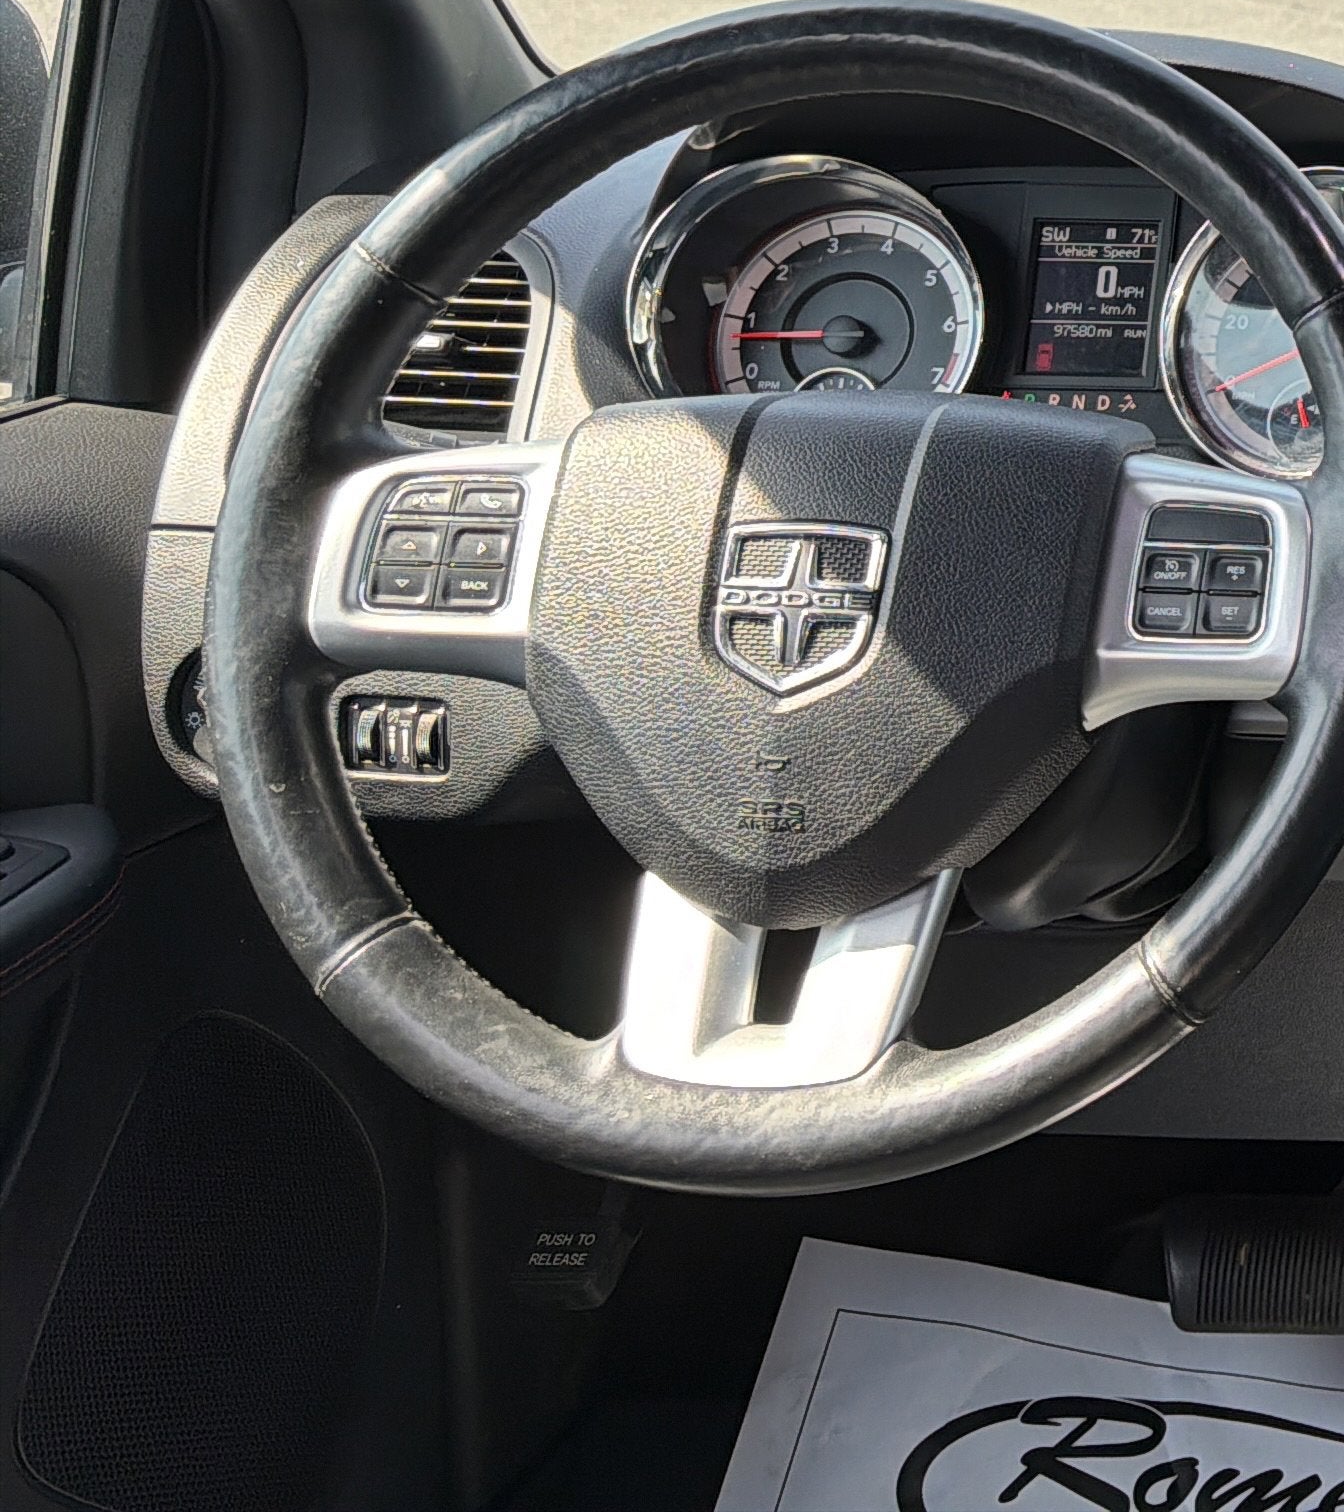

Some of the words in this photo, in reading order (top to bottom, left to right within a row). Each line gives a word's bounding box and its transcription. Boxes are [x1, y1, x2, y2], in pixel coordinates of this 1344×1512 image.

[1041, 226, 1071, 242] SW
[827, 239, 840, 255] 3
[880, 239, 895, 256] 4
[1055, 244, 1099, 258] Vehicle
[1102, 245, 1141, 260] Speed
[775, 265, 790, 282] 2
[924, 269, 938, 287] 5
[1096, 265, 1119, 299] 0
[1117, 286, 1145, 299] MPH
[1054, 301, 1083, 315] MPH
[1101, 302, 1137, 316] km/h
[747, 311, 757, 329] 1
[942, 315, 956, 333] 6
[1225, 313, 1249, 330] 20
[1123, 328, 1148, 339] RUN
[745, 362, 759, 380] 0
[930, 367, 945, 384] 7
[757, 380, 781, 390] RPM
[1071, 393, 1086, 410] N
[1097, 394, 1111, 411] D
[1290, 413, 1299, 425] E
[1153, 571, 1188, 581] ON/OFF
[1226, 565, 1246, 576] RES
[460, 580, 489, 591] BACK
[721, 588, 877, 611] DODGE
[1146, 606, 1183, 617] CANCEL
[1221, 605, 1239, 616] SET
[536, 1233, 574, 1246] PUSH
[577, 1233, 597, 1246] TO
[528, 1252, 589, 1266] RELEASE
